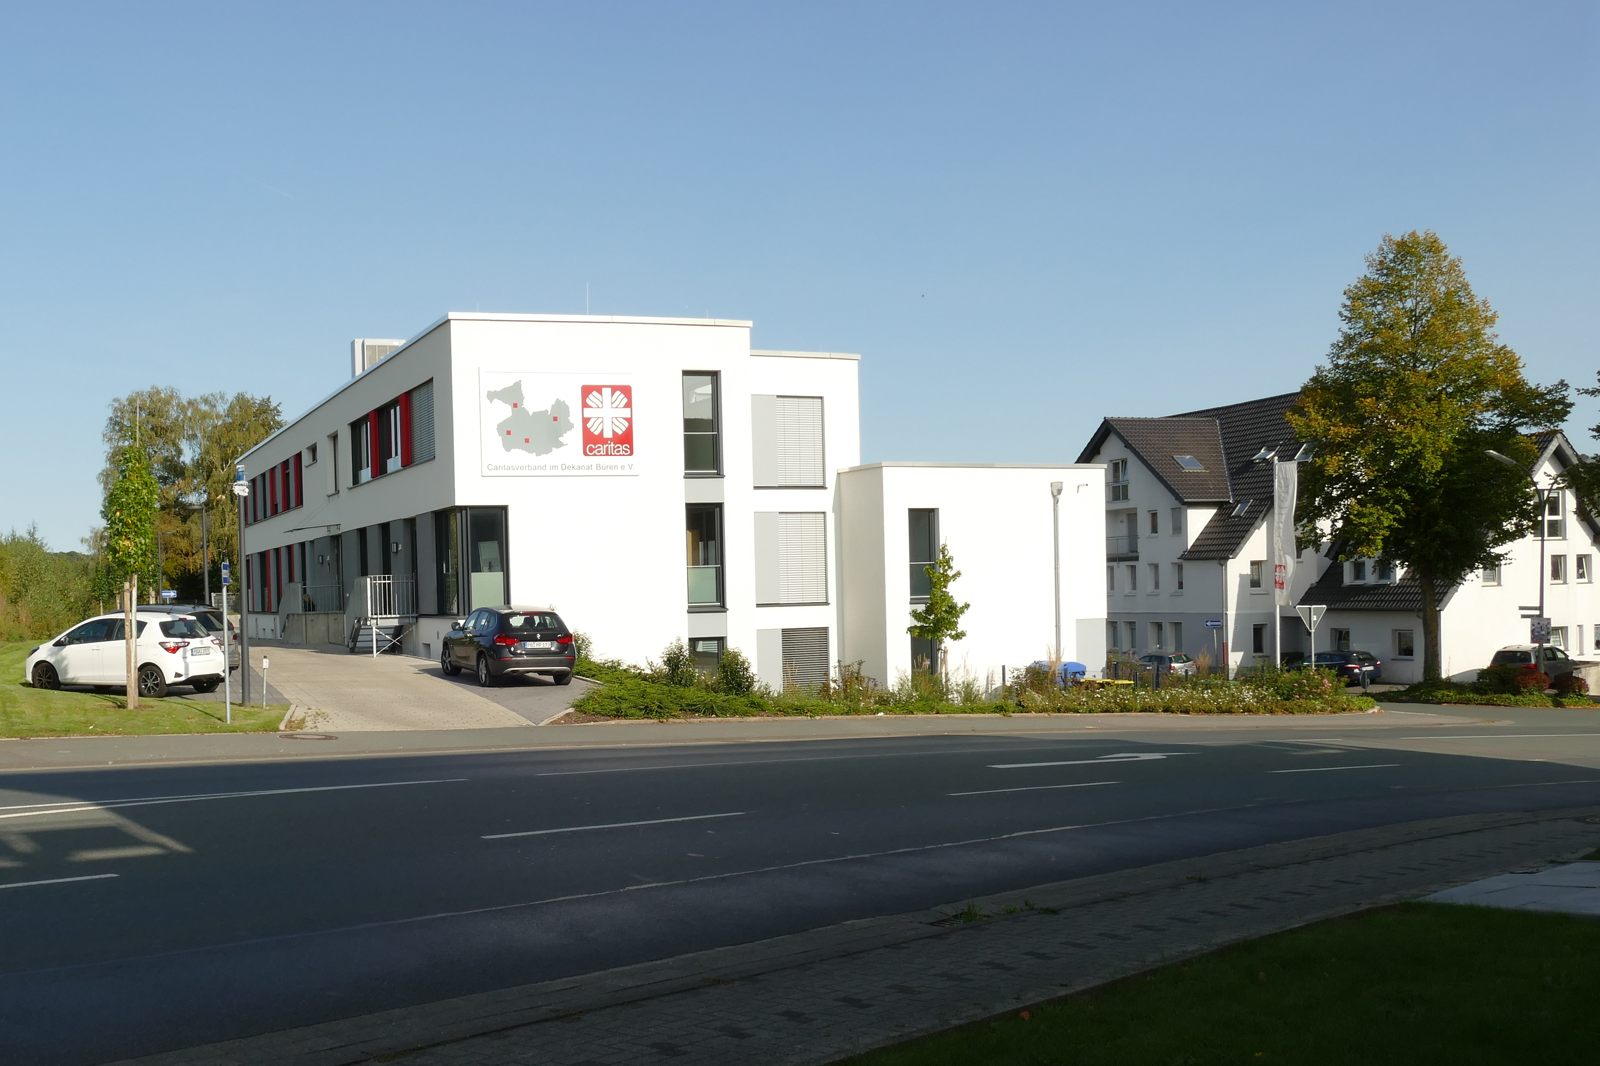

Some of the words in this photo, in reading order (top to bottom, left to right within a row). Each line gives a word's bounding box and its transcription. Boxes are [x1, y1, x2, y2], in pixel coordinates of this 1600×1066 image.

[586, 441, 631, 456] caritas
[487, 463, 545, 472] Caritasverband
[550, 463, 559, 471] im
[560, 463, 592, 471] Dekanat
